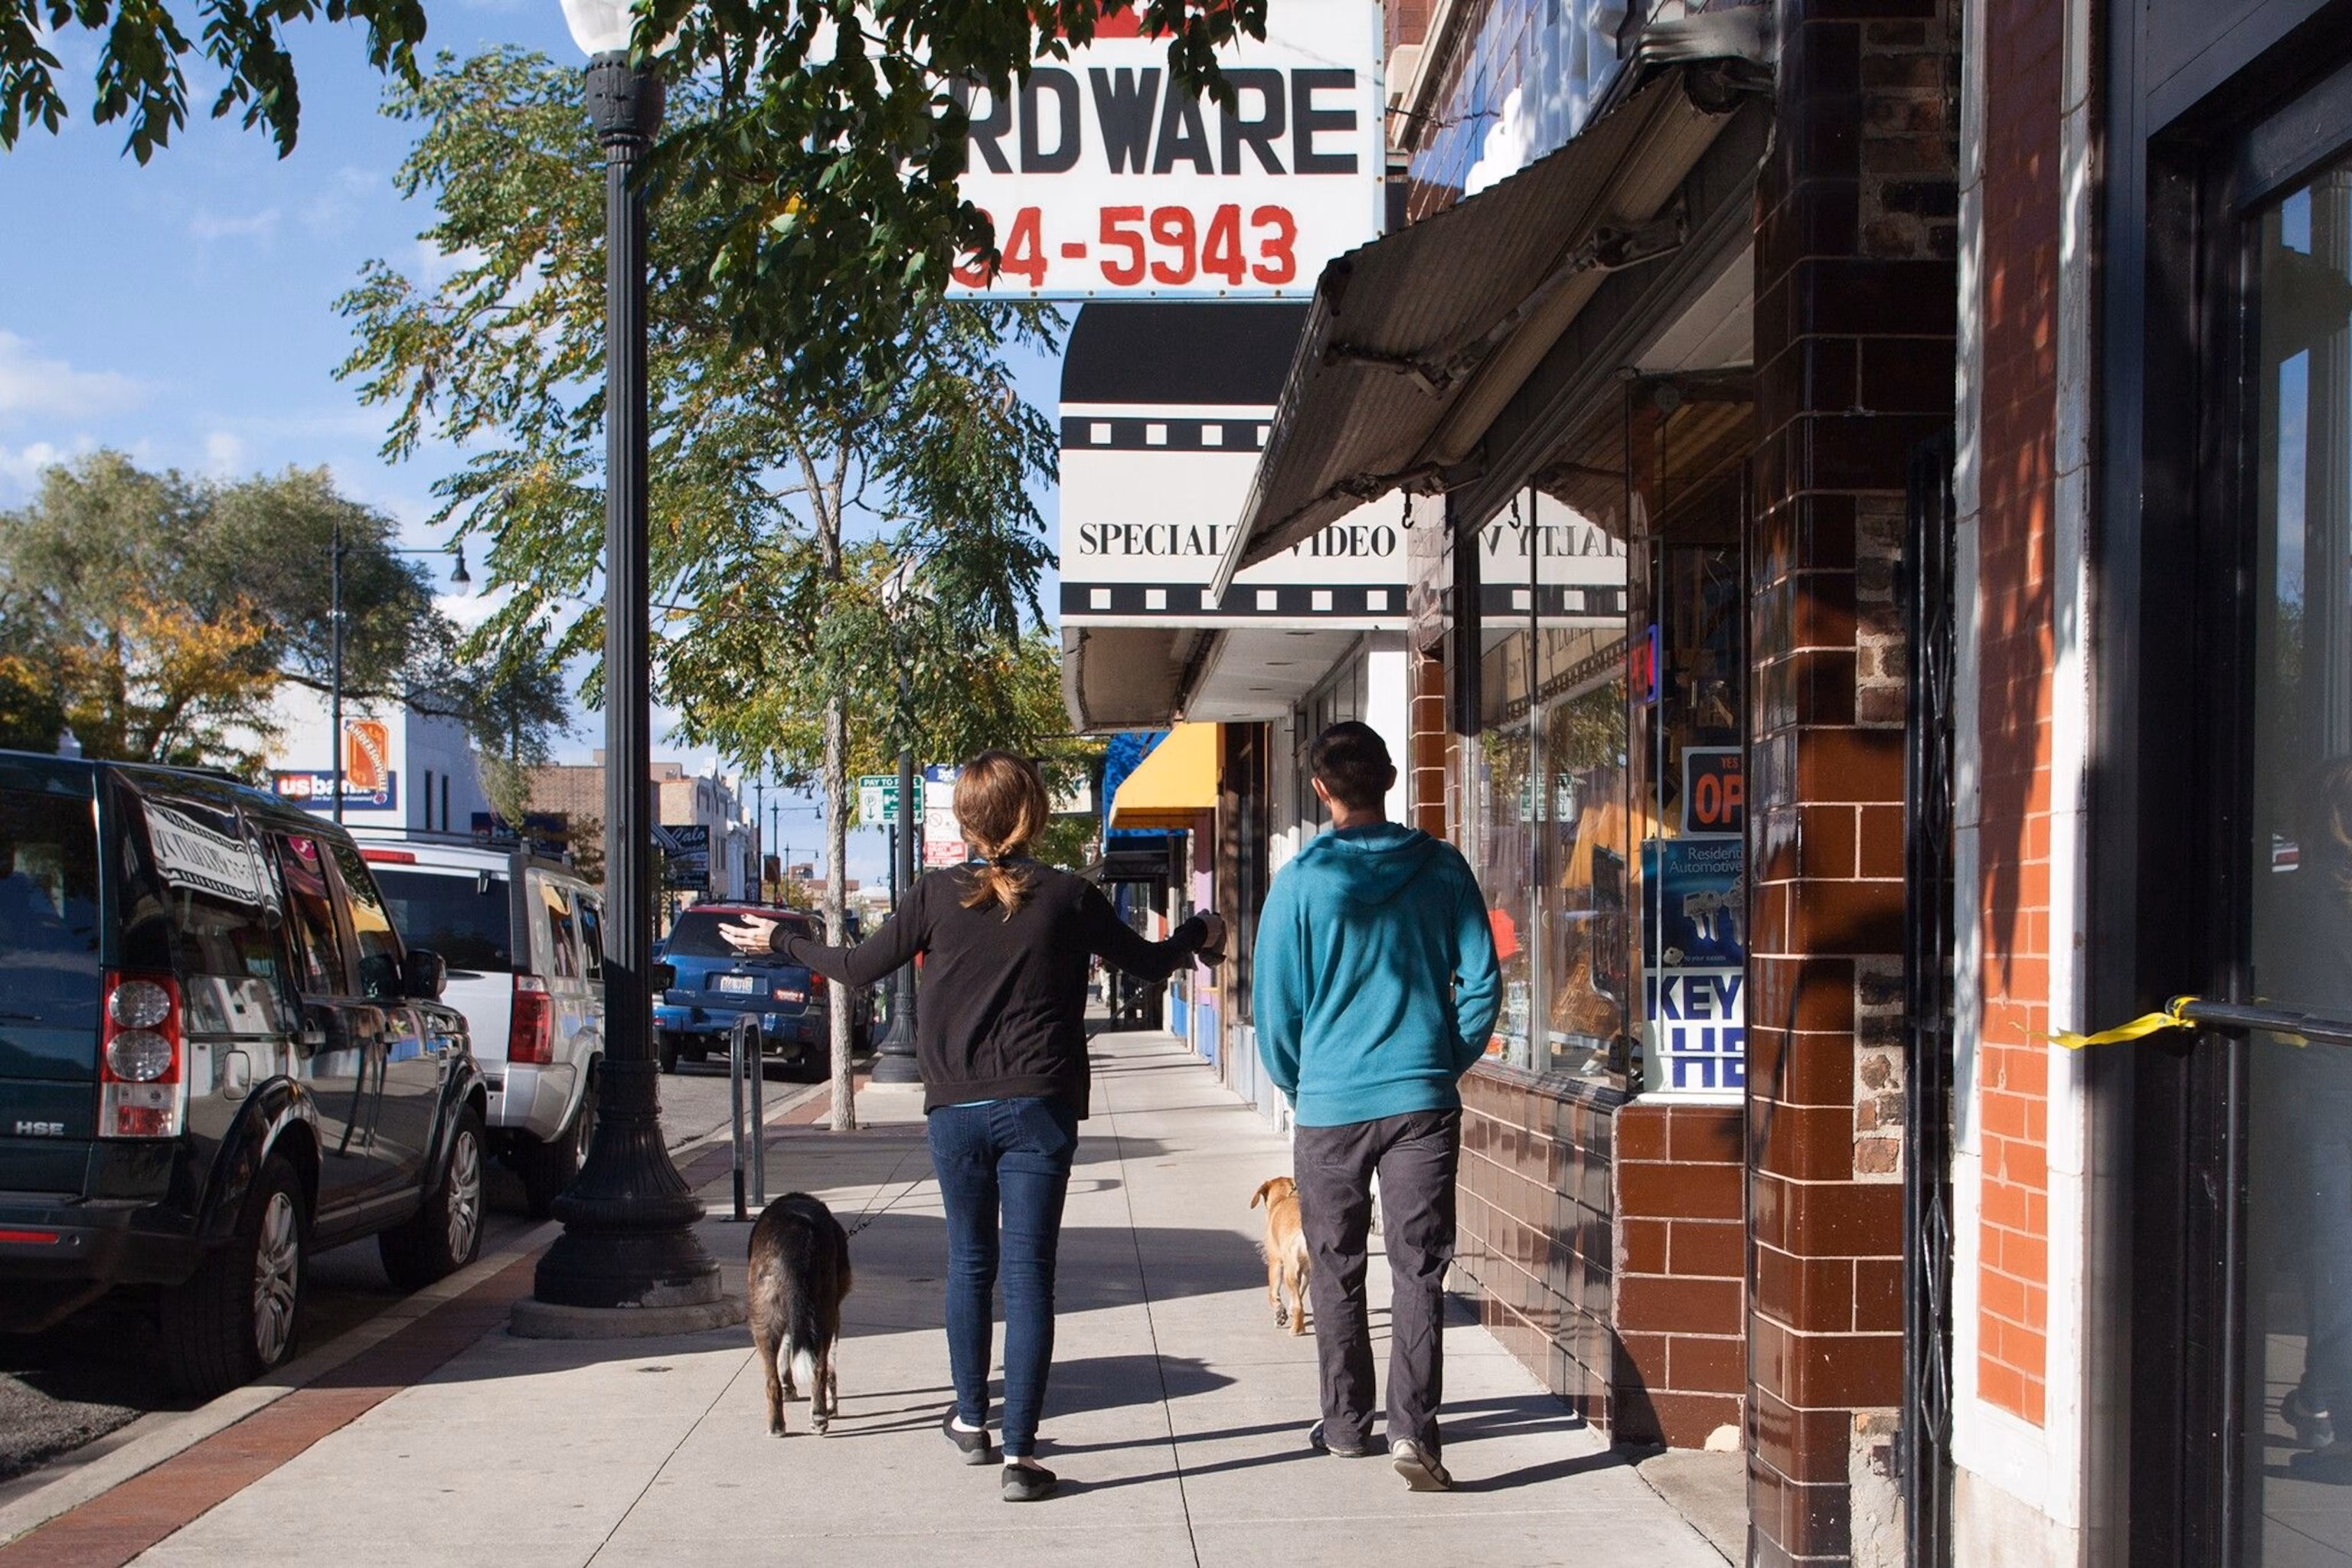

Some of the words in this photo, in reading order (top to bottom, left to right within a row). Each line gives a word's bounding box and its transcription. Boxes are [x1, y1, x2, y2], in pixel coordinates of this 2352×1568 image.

[946, 67, 1359, 175] RDWARE
[1721, 756, 1739, 769] YES
[1695, 773, 1743, 824] OP
[1687, 847, 1743, 860] Resident
[1669, 860, 1743, 874] Automotive
[1672, 1027, 1744, 1087] HE
[16, 1121, 64, 1136] HSE
